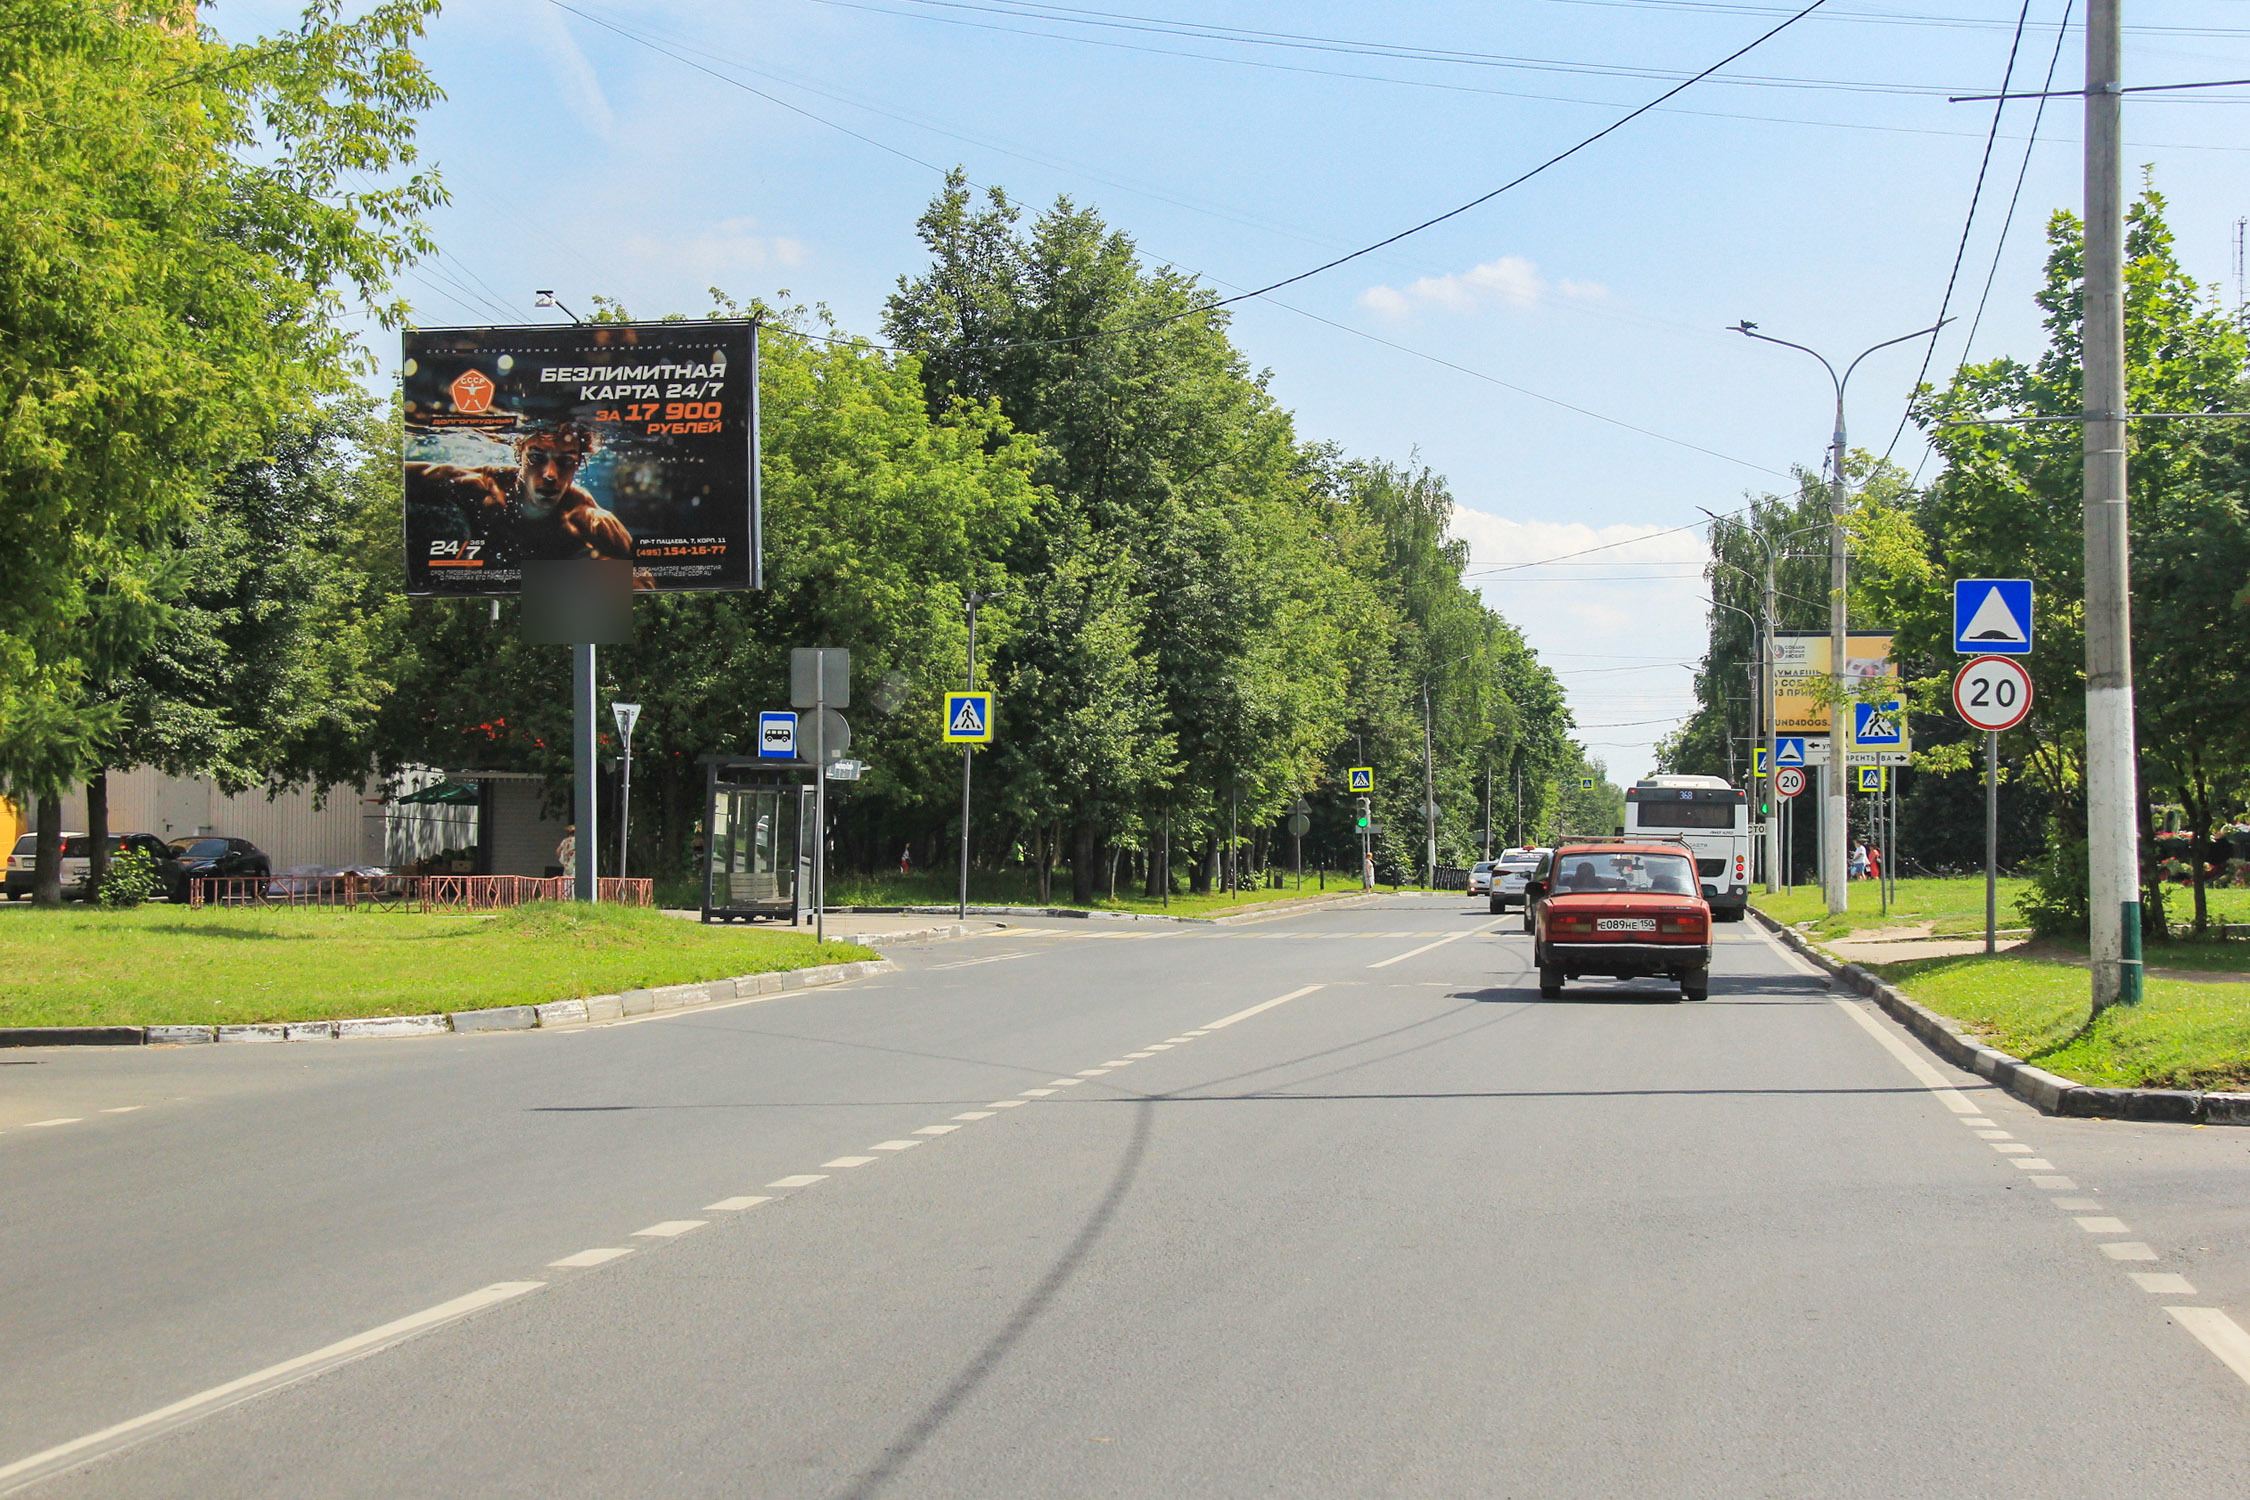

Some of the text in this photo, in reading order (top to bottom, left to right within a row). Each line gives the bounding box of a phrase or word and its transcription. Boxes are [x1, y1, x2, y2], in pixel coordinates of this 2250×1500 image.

[461, 376, 485, 385] СССР
[540, 364, 727, 383] БЕЗЛИМИТНАЯ
[580, 381, 724, 401] КАРТА 24/7
[595, 401, 723, 422] ЗА 17 900
[432, 417, 515, 426] ДОЛГОПРУДНЫЙ
[647, 419, 722, 435] РУБЛЕЙ
[429, 539, 482, 560] 24/7
[664, 545, 727, 555] 154-16-77
[1970, 678, 2016, 707] 20
[1782, 776, 1799, 788] 20
[1679, 790, 1693, 800] 368
